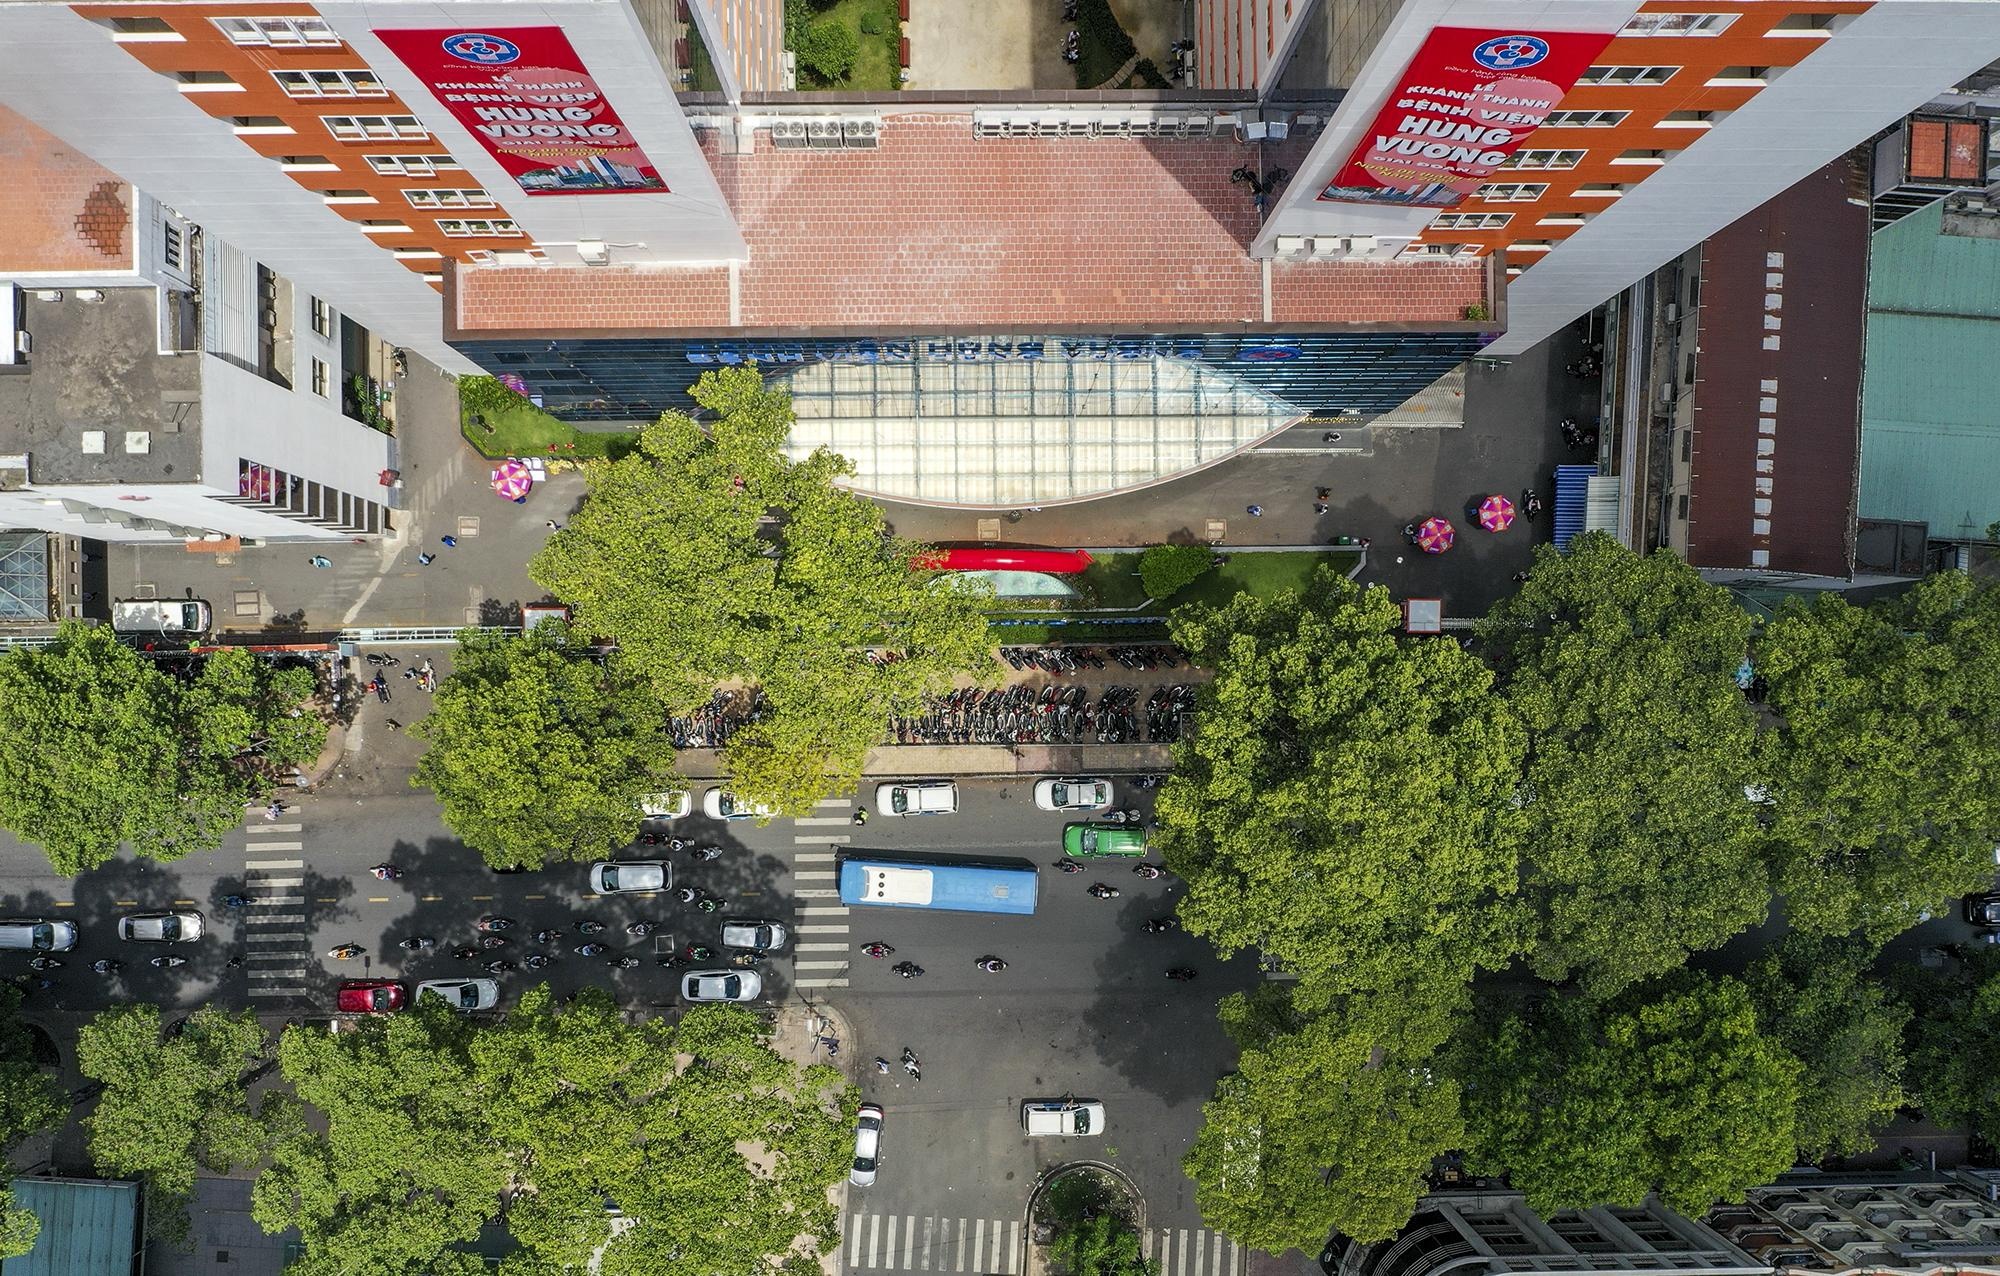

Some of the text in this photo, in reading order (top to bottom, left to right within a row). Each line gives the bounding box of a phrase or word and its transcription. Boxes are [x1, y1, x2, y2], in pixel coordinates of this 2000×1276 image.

[444, 91, 599, 104] BỆNH VIỆN
[473, 104, 593, 122] HÙNG
[1396, 98, 1545, 126] BỆNH VIỆN
[475, 123, 620, 138] VƯƠNG
[1397, 115, 1513, 146] HÙNG
[1376, 135, 1508, 167] VƯƠNG
